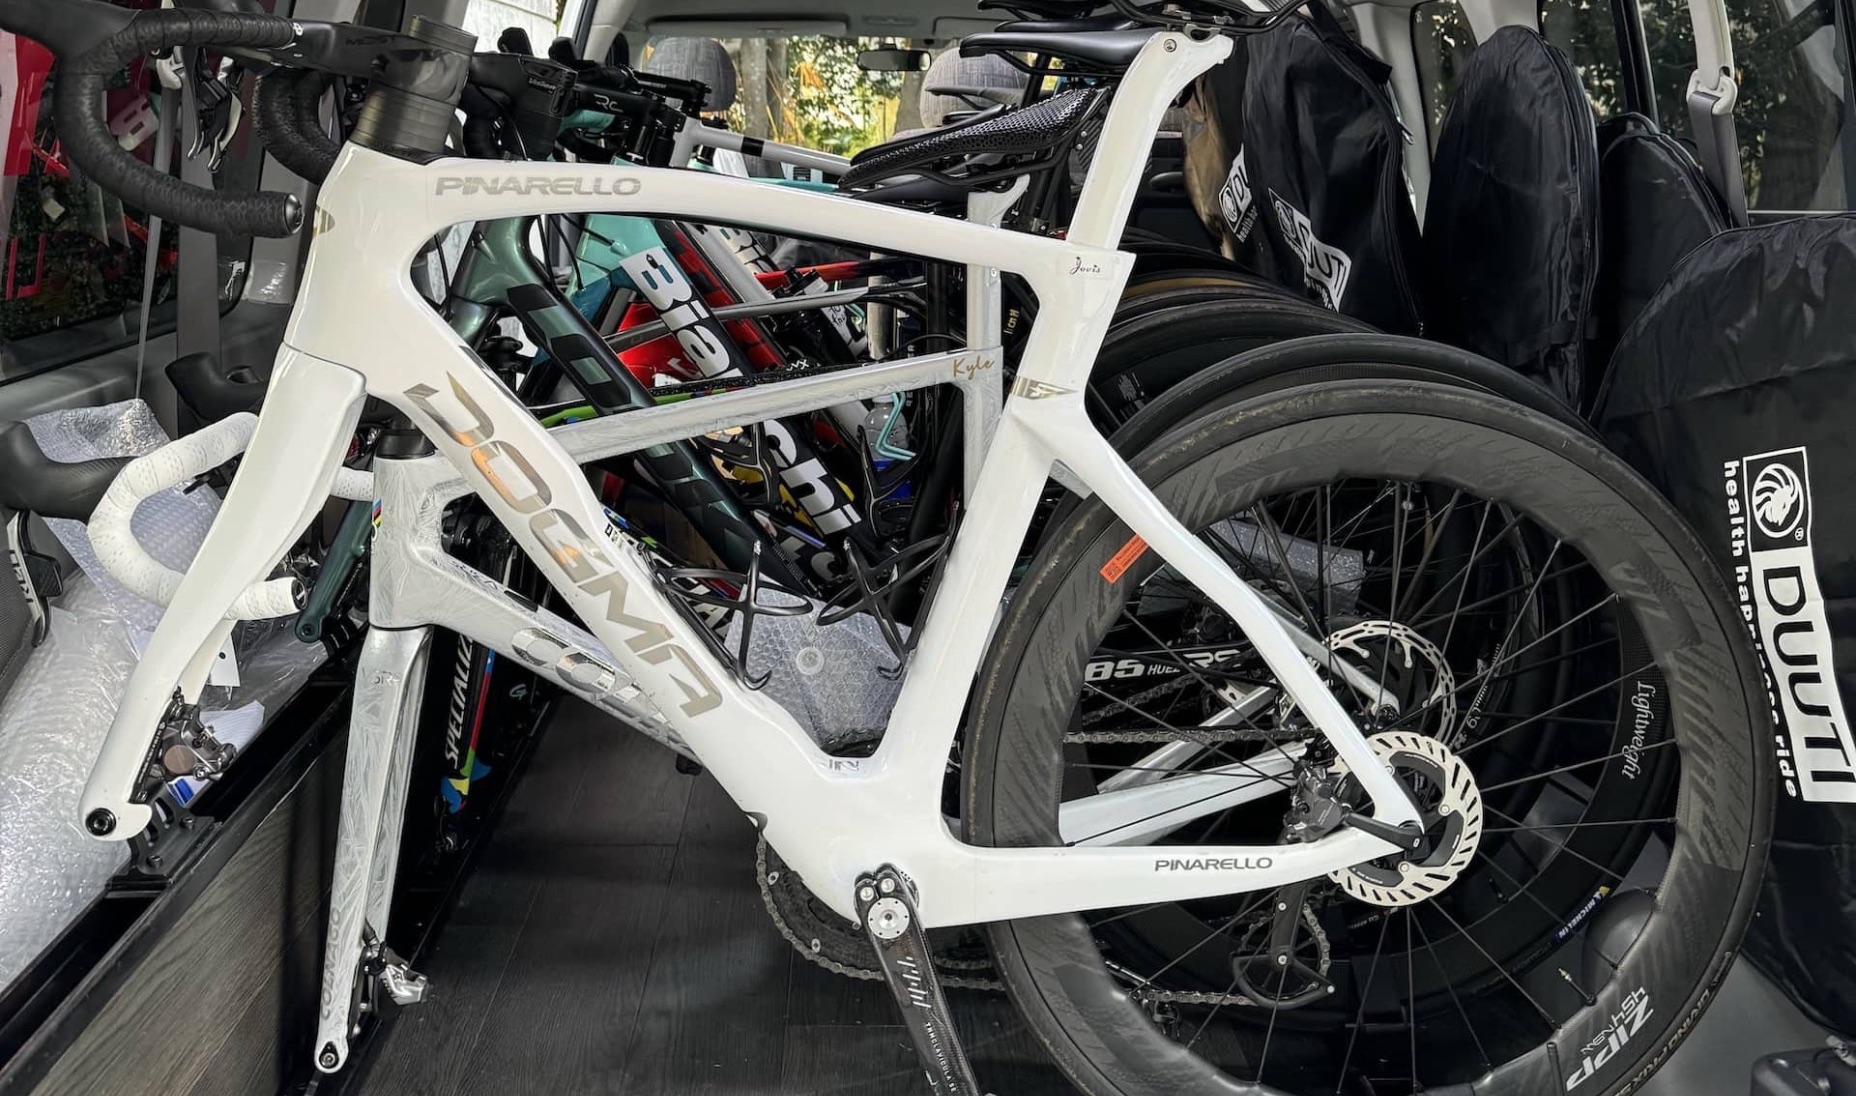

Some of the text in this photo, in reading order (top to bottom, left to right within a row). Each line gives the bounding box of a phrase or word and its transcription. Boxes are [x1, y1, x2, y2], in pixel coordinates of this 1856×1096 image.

[435, 176, 642, 196] PINARELLO
[1069, 256, 1101, 275] Jovis
[952, 355, 995, 380] Kyle
[403, 371, 724, 718] DOGMA
[1724, 460, 1747, 557] health
[1775, 735, 1797, 797] ride
[1762, 566, 1856, 783] DUUTI
[445, 634, 473, 770] SPECIALIZ
[1621, 680, 1656, 780] Lightweight
[1155, 857, 1273, 871] PINARELLO
[321, 907, 340, 1020] COLNAGO
[1558, 898, 1597, 939] MICHELIN
[1566, 995, 1655, 1091] ZIPP
